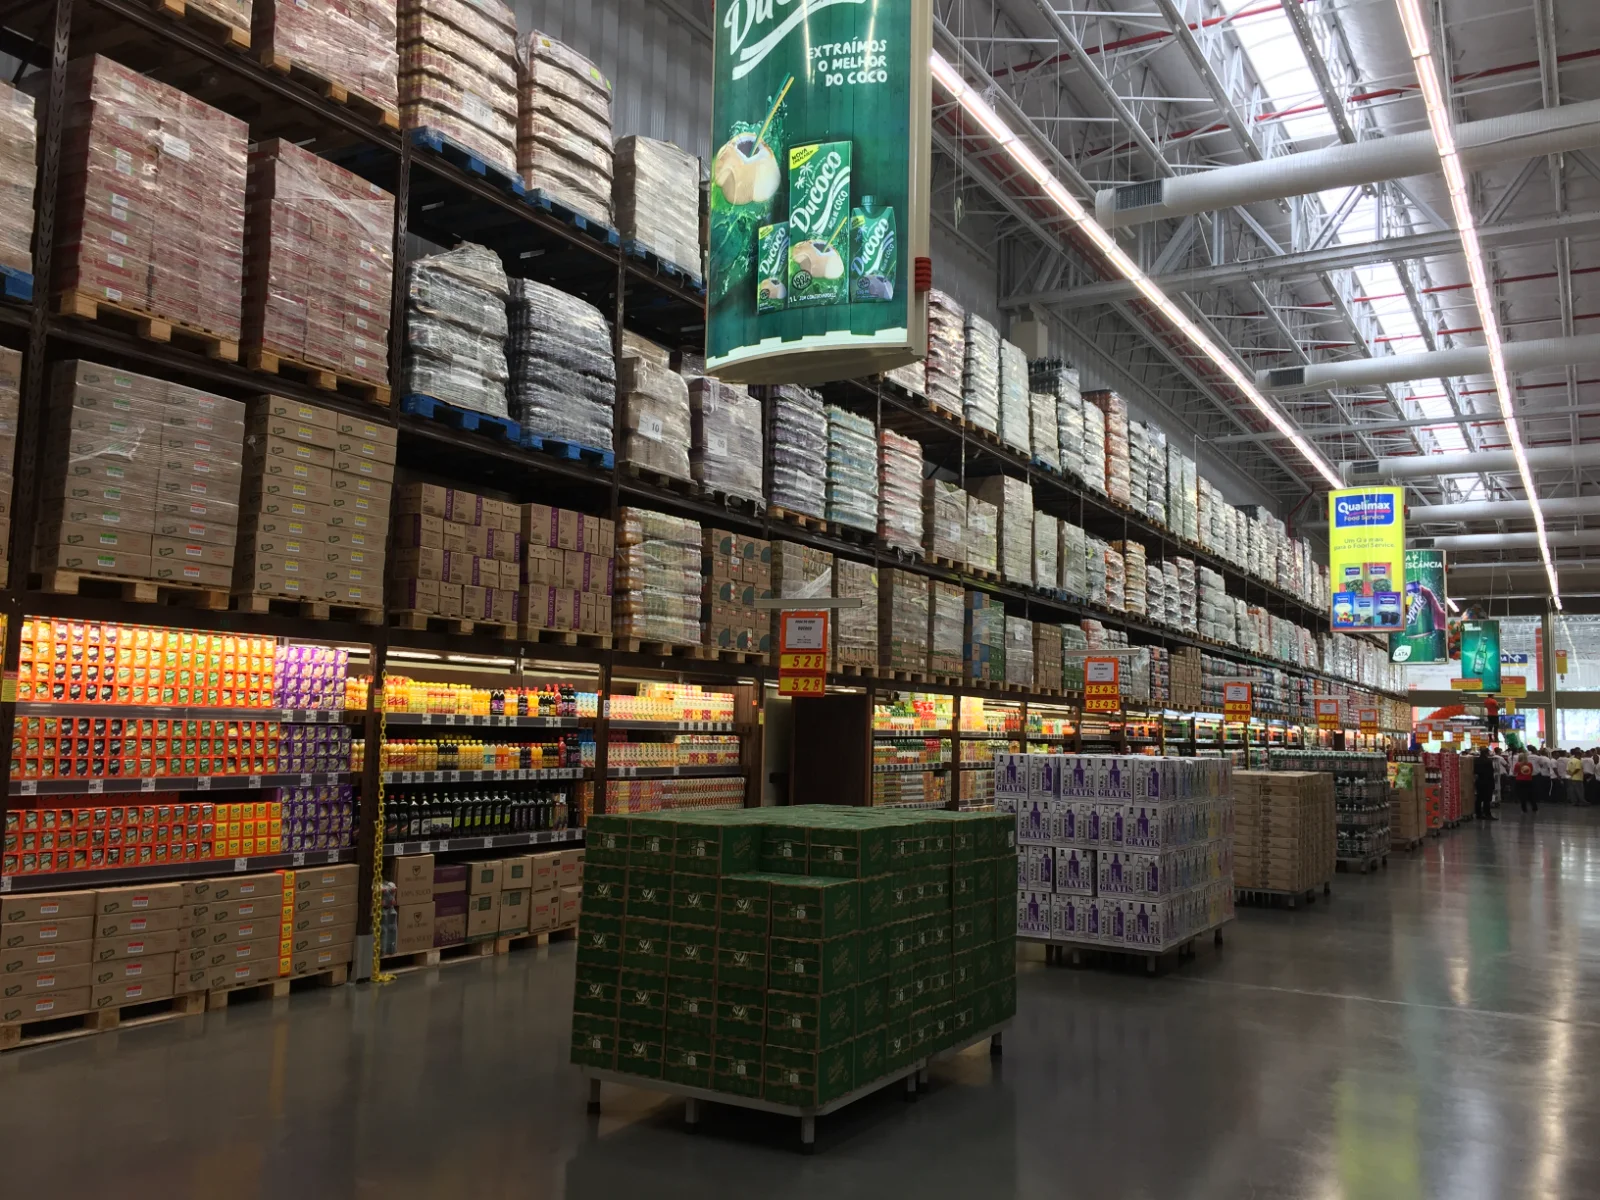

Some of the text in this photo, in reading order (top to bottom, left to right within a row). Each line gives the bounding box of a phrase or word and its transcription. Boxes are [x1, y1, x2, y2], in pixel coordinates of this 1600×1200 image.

[809, 36, 887, 59] EXTRAÍMOS
[818, 55, 887, 72] O MELHOR
[825, 70, 888, 87] DO COCO
[789, 151, 842, 234] Ducoco
[834, 190, 848, 210] COCO
[851, 218, 889, 277] Ducoco
[651, 422, 660, 433] 10
[1337, 500, 1390, 515] Qualimax
[996, 783, 1027, 792] GRATIS
[1062, 788, 1095, 797] GRATIS
[1098, 788, 1131, 798] GRATIS
[1019, 830, 1051, 839] GRATIS
[1125, 837, 1160, 847] GRATIS
[1058, 879, 1090, 889] GRATIS
[1099, 882, 1133, 893] GRATIS
[1017, 921, 1050, 932] GRATIS
[1125, 933, 1161, 944] GRATIS
